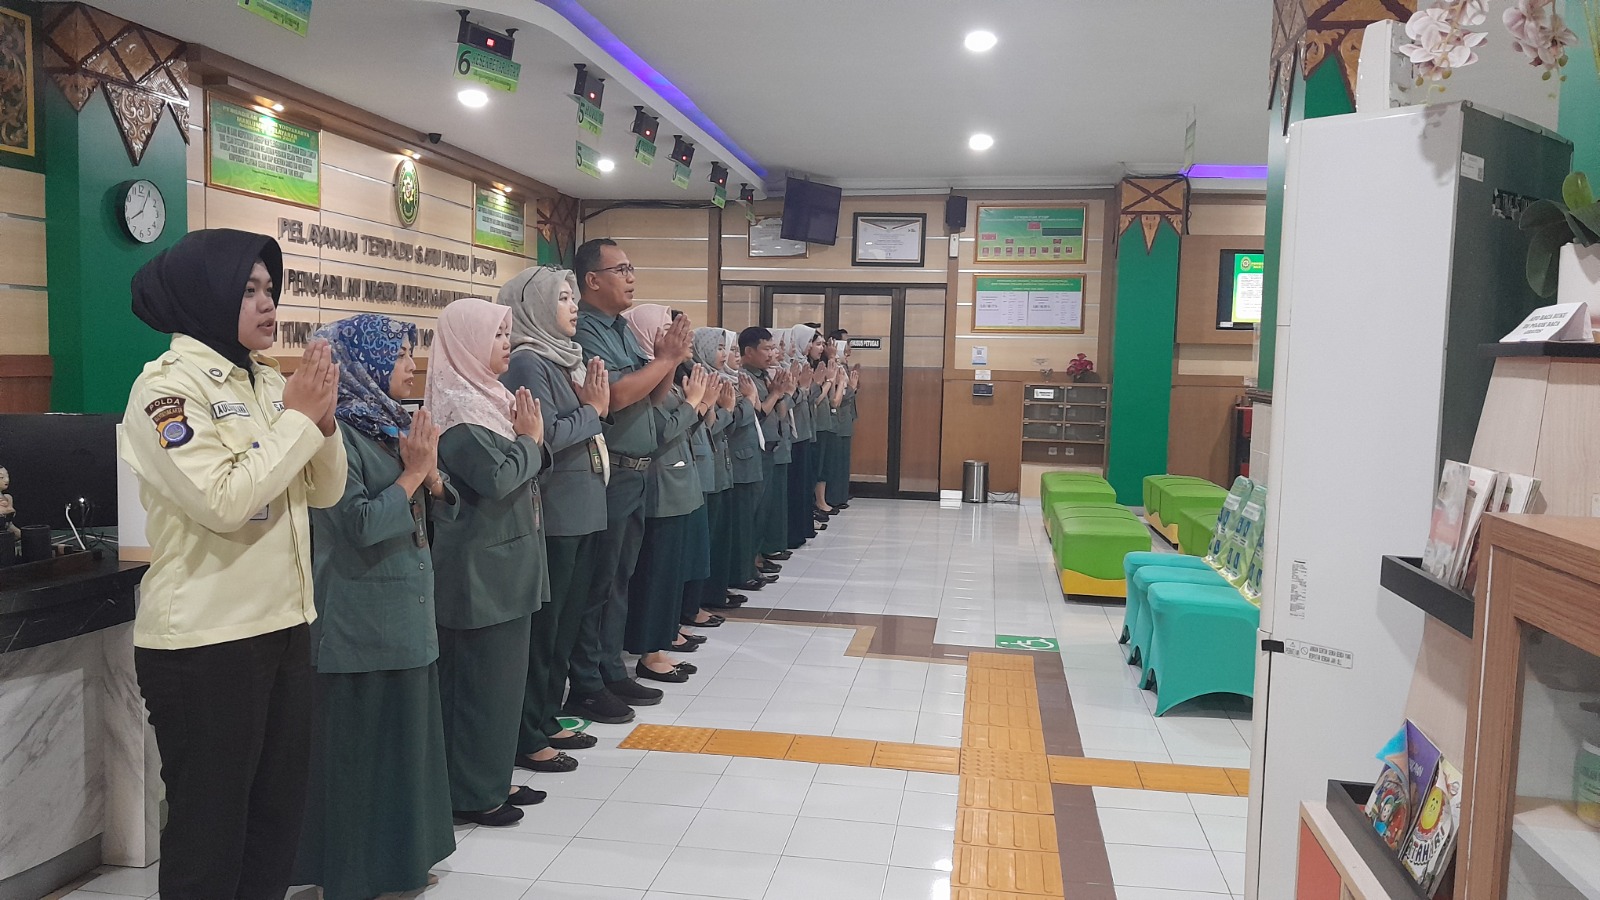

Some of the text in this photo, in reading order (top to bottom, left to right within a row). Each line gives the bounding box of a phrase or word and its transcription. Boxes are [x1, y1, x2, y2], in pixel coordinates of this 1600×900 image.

[458, 50, 471, 75] 6
[578, 101, 587, 124] 5
[138, 185, 144, 194] 12
[152, 200, 156, 208] 2
[156, 210, 158, 218] 3
[140, 230, 143, 238] 6
[148, 228, 151, 236] 5
[277, 217, 359, 253] PELAYANAN
[361, 233, 414, 262] TERPADU
[441, 250, 470, 272] PINTU
[284, 268, 361, 301] PENGADILAN
[149, 398, 180, 412] POLDA
